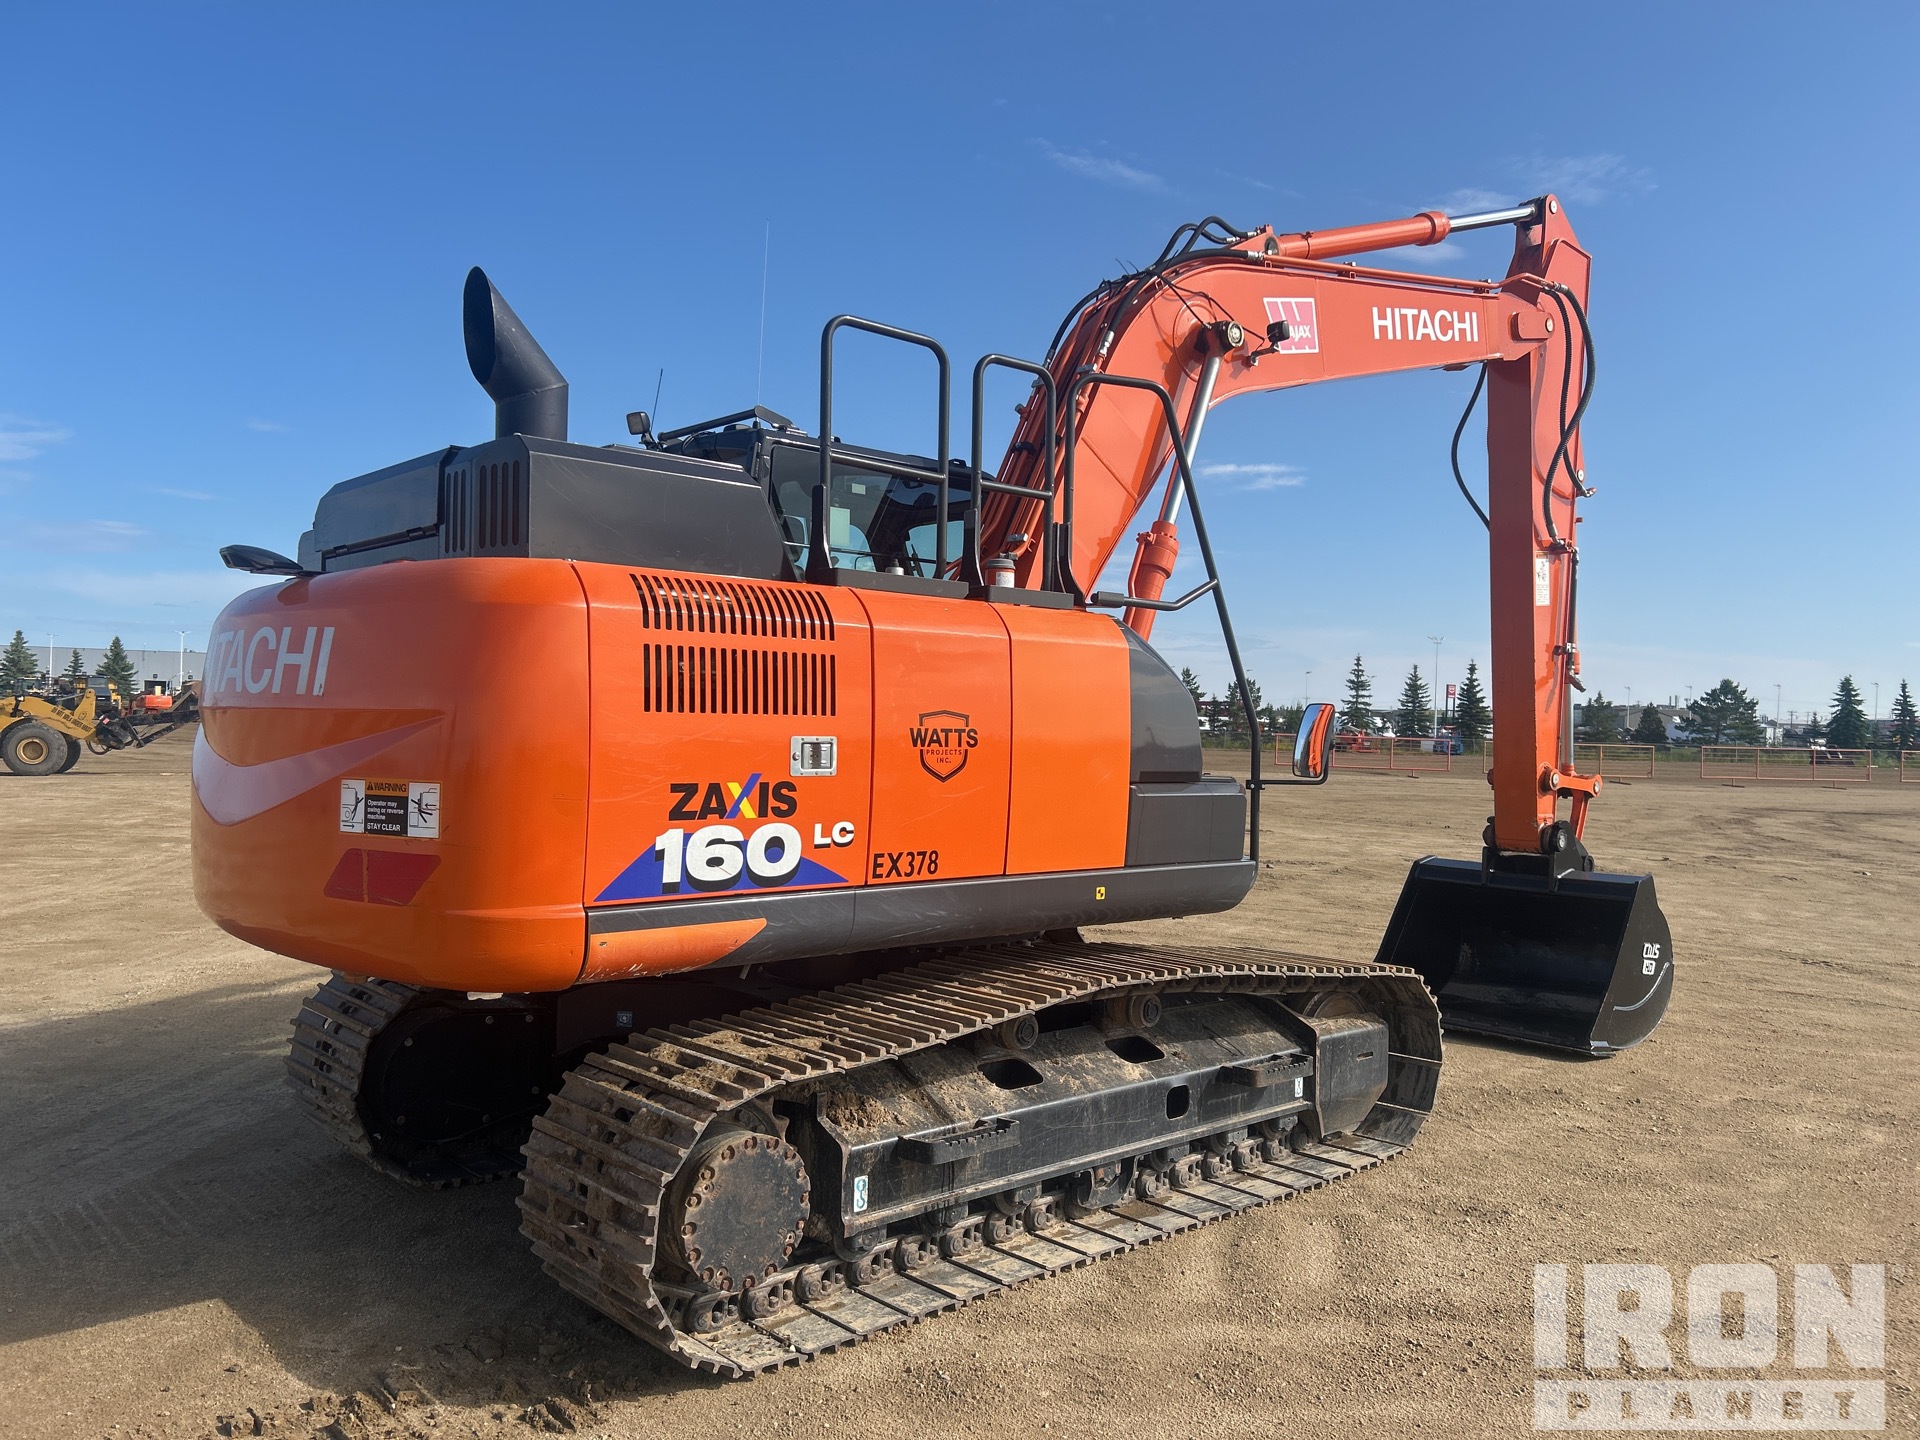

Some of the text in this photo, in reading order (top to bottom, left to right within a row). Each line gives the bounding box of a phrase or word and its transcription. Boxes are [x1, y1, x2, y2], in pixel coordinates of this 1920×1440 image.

[1372, 306, 1479, 342] HITACHI
[909, 727, 978, 748] WATTS
[374, 783, 407, 792] WARNING
[668, 773, 798, 821] ZAXIS
[367, 822, 381, 830] STAY
[655, 821, 855, 894] 160 LC
[871, 850, 939, 879] EX378
